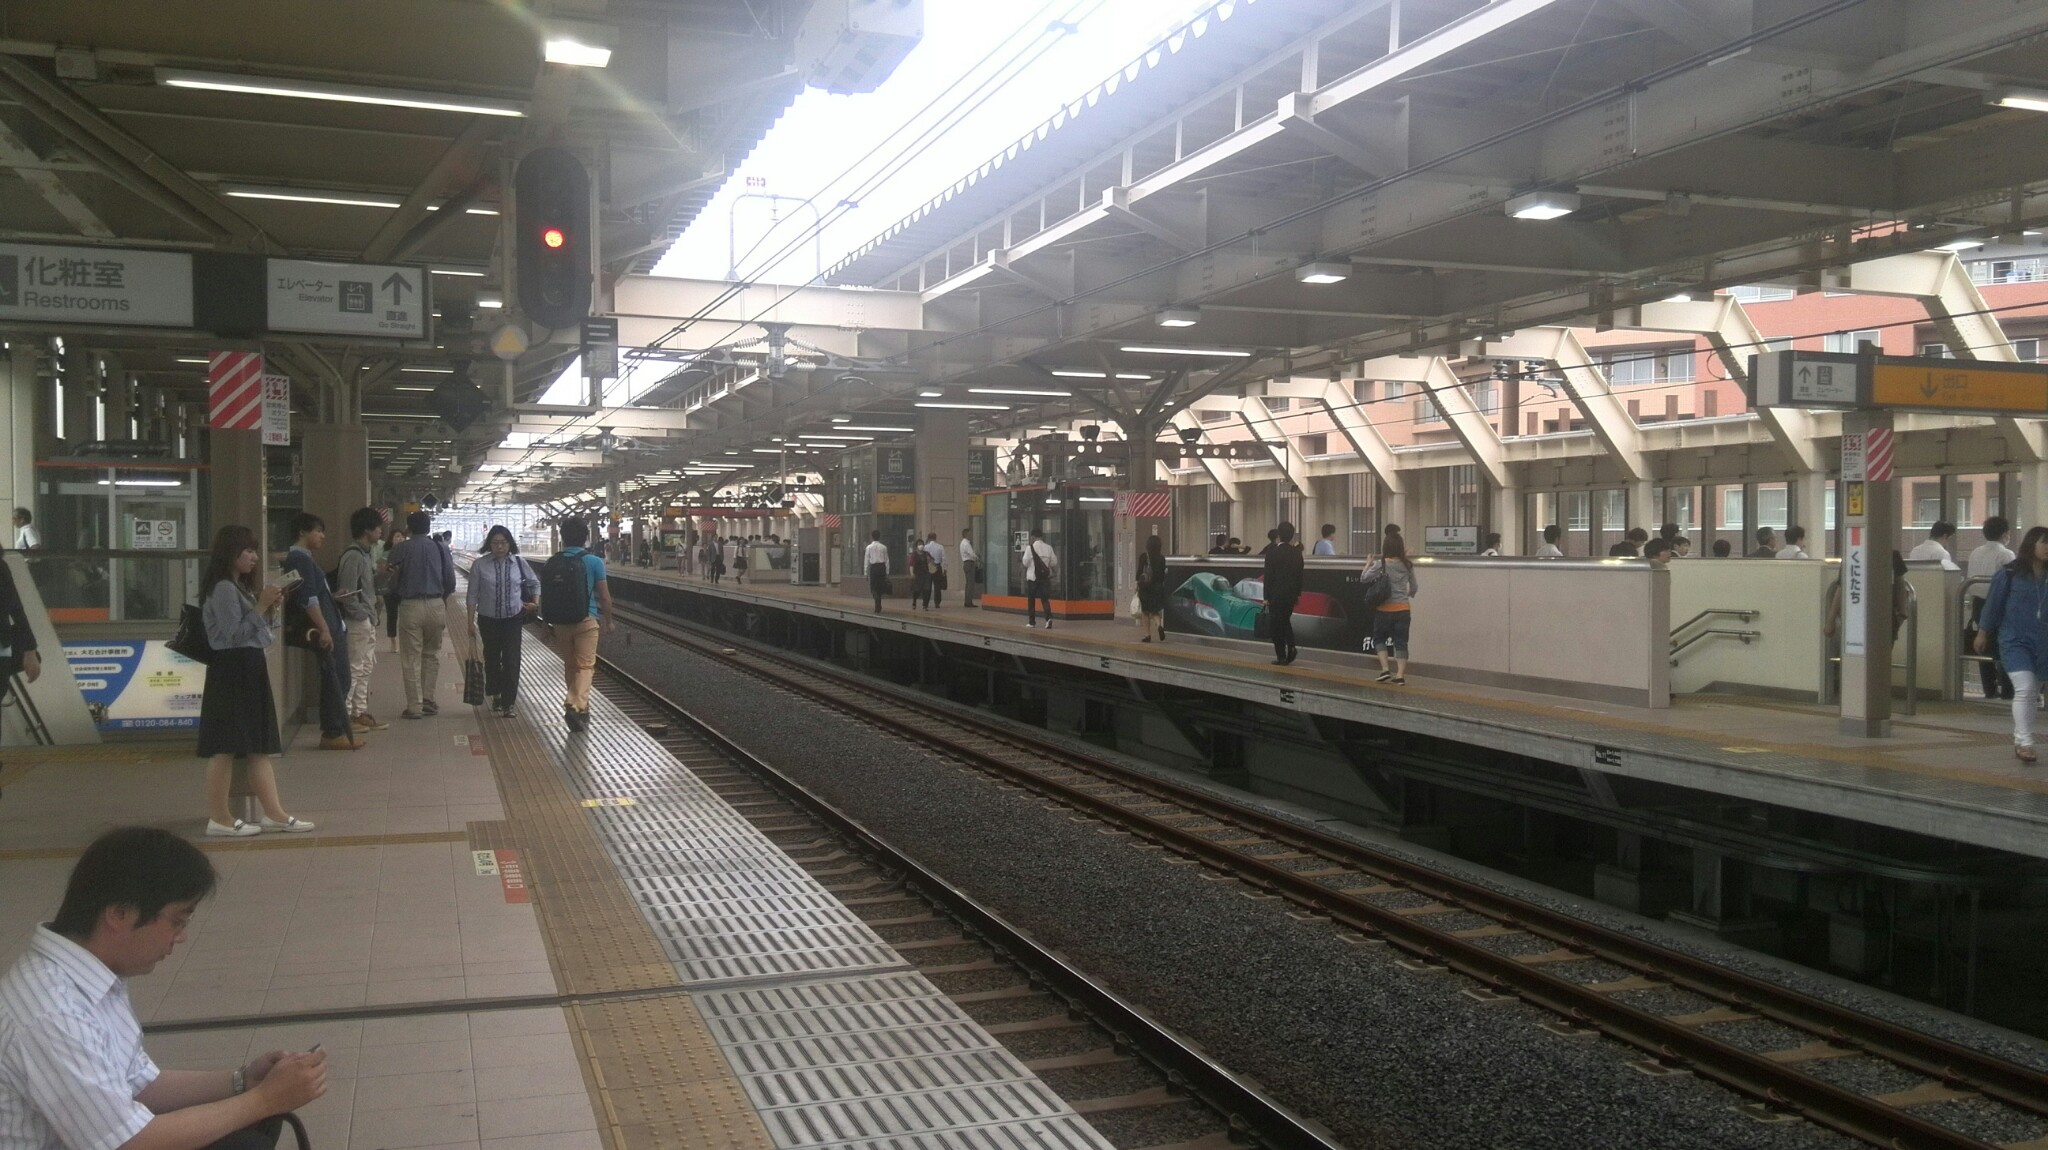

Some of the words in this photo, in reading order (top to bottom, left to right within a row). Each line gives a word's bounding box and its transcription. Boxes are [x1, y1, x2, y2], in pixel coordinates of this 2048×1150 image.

[24, 256, 126, 289] 化粧室
[277, 278, 333, 292] エレベーター
[24, 291, 131, 312] Restrooms
[298, 293, 334, 304] Elevator
[1850, 550, 1861, 605] くにたち
[135, 718, 193, 728] 0120-084-840
